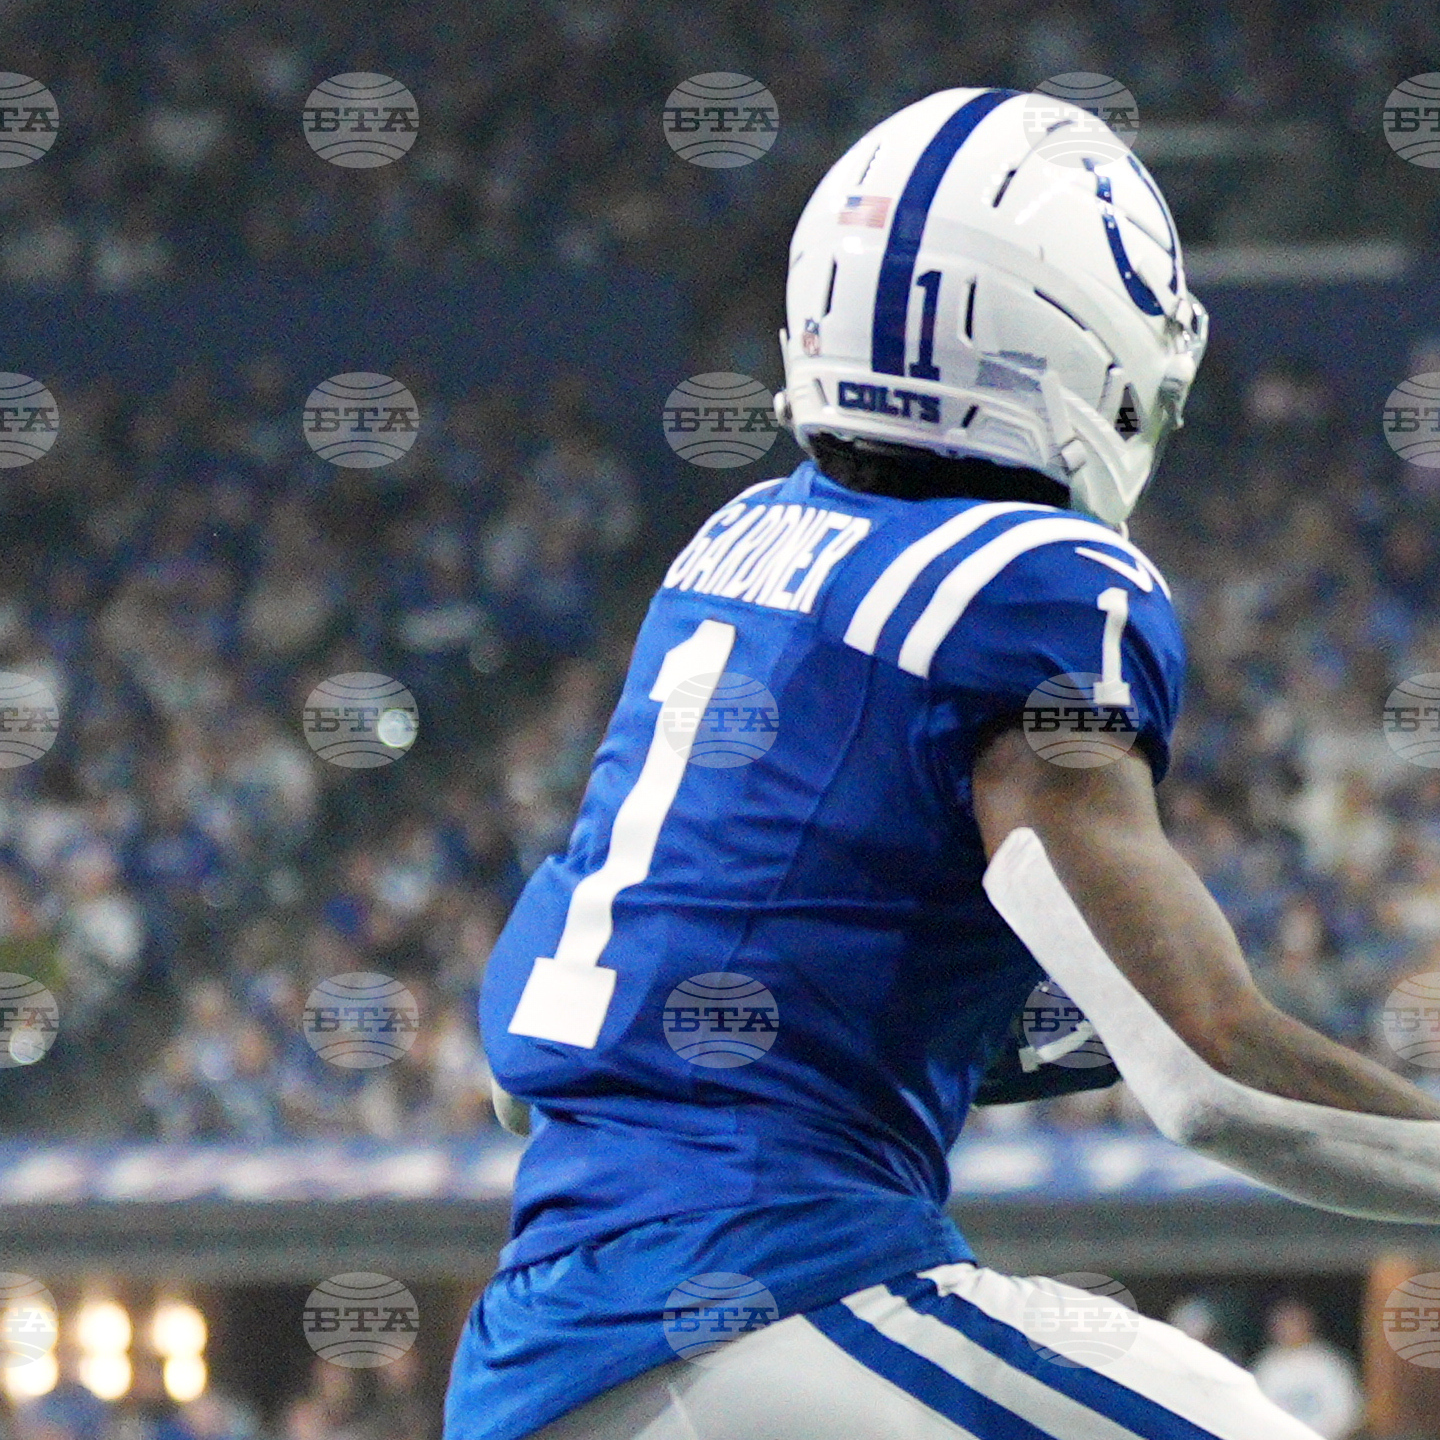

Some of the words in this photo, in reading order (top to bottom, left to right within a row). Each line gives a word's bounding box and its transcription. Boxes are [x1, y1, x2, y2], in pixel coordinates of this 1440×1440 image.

[908, 269, 943, 381] 1
[838, 381, 941, 424] COLTS
[662, 502, 872, 614] GARDNER
[1093, 587, 1131, 706] 1
[507, 619, 736, 1049] 1
